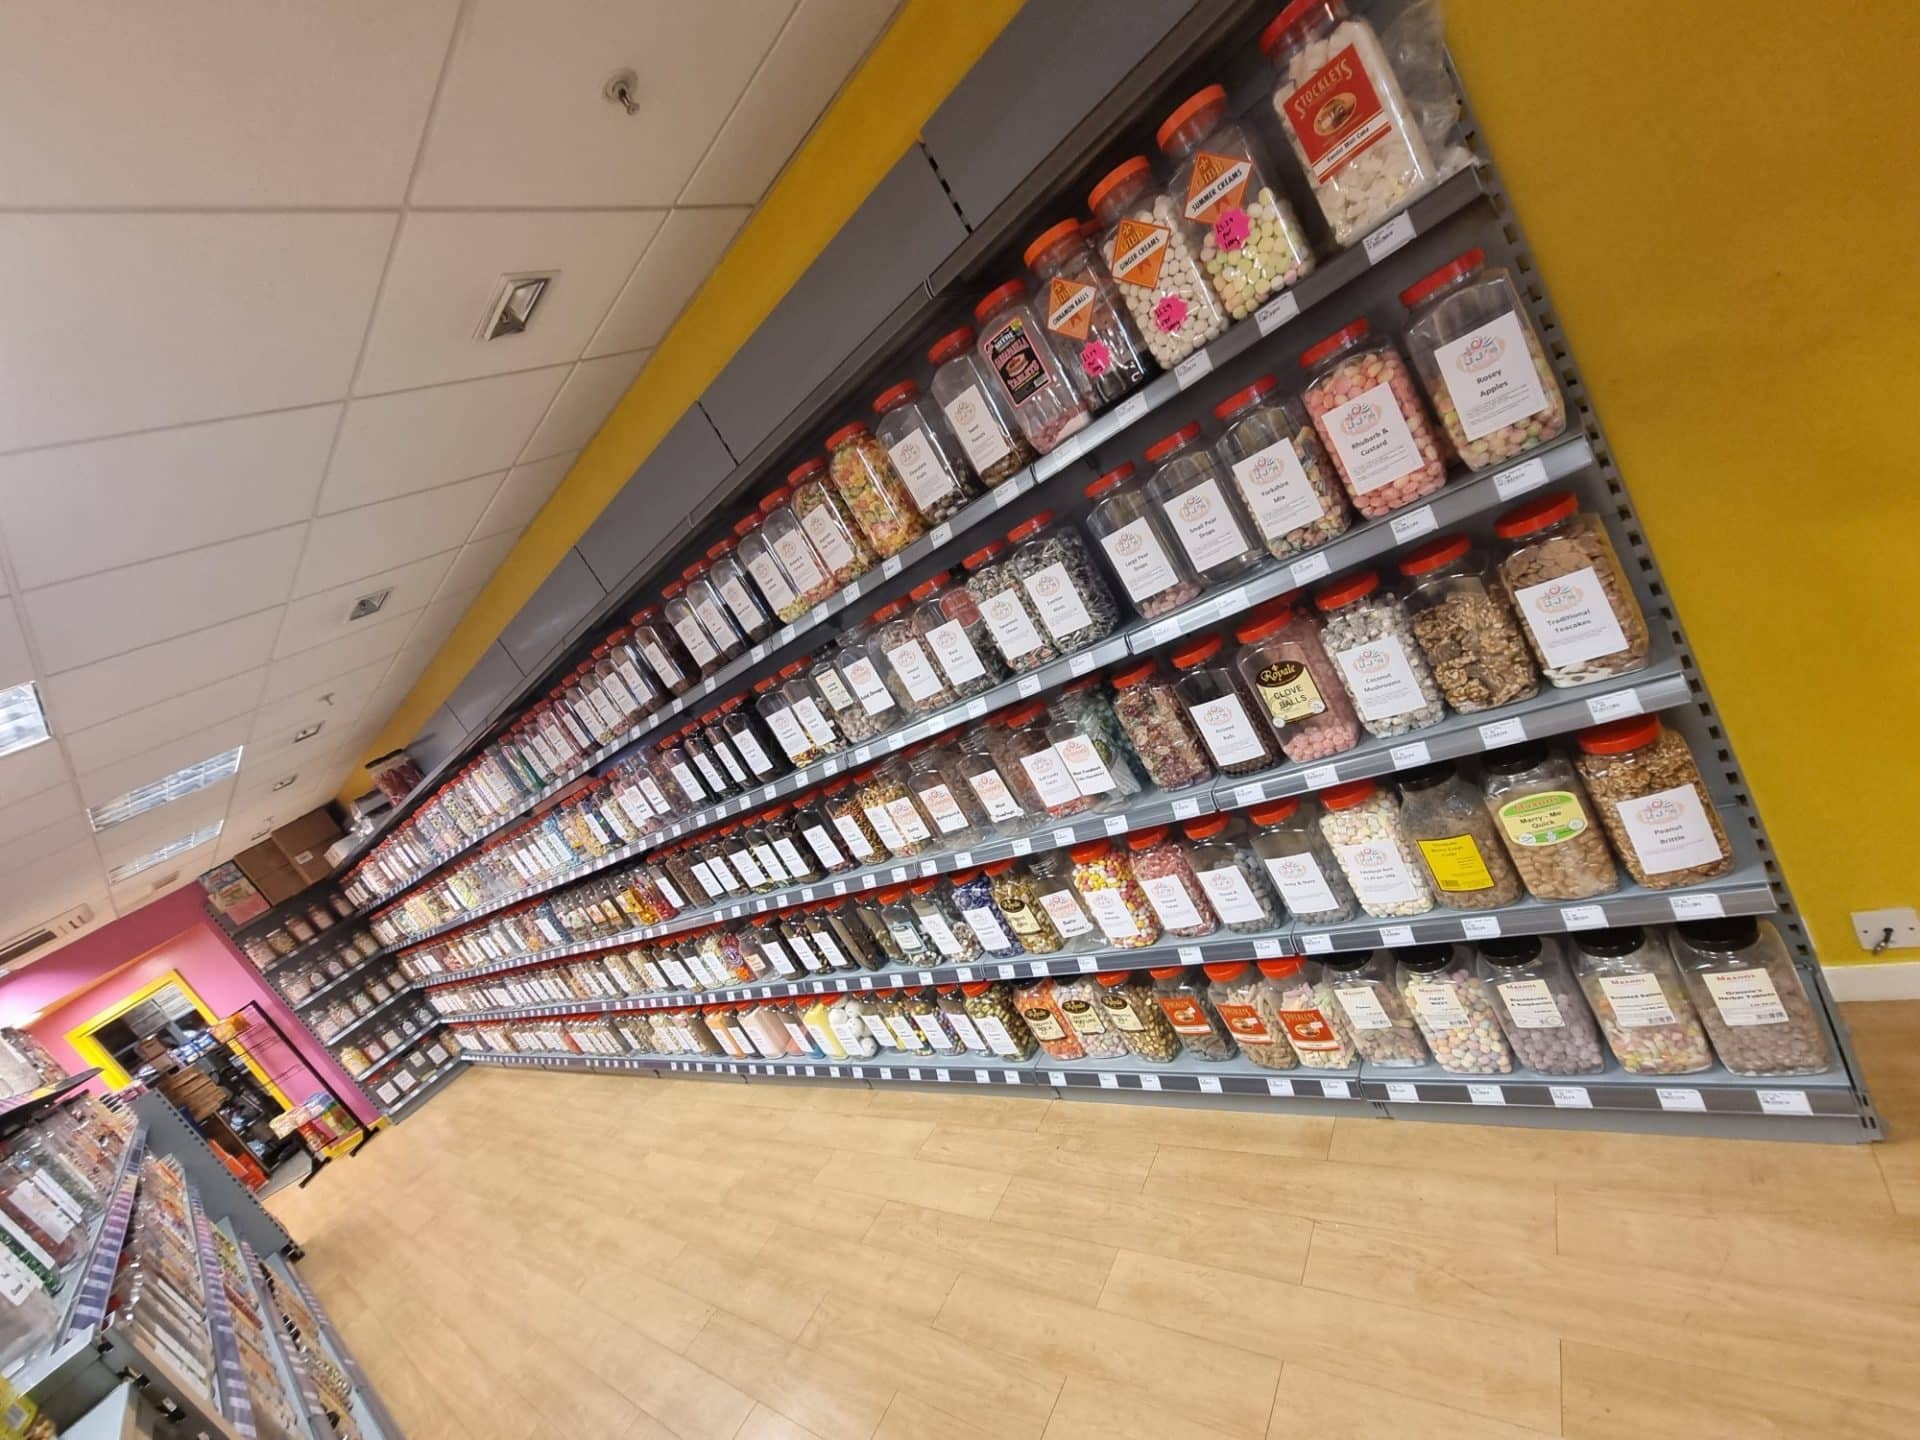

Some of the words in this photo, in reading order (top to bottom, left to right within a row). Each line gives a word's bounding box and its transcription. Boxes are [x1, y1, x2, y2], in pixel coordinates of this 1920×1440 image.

[1293, 58, 1353, 120] STOCKLEYS
[1191, 190, 1217, 212] SUMMER
[1217, 169, 1243, 192] CREAMS
[1119, 251, 1142, 273] GINGER
[1139, 236, 1161, 256] CREAMS
[1052, 301, 1075, 325] CINNAMON
[1074, 292, 1090, 307] BALLS
[1476, 368, 1502, 385] Rosey
[1479, 380, 1509, 399] Apples
[1350, 431, 1381, 450] Rhubarb
[1380, 427, 1389, 435] &
[1359, 439, 1388, 457] Custard
[1261, 480, 1289, 497] Yorkshire
[1272, 494, 1286, 504] Mix
[1189, 522, 1204, 534] Small
[1547, 608, 1592, 626] Traditional
[1554, 618, 1592, 634] Teacakes
[1272, 682, 1303, 701] CLOVE
[1363, 679, 1402, 694] Mushrooms
[1279, 693, 1307, 708] BALLS
[1520, 814, 1542, 824] Marry
[1549, 809, 1562, 817] Me
[1531, 819, 1555, 829] Quick
[1653, 825, 1682, 836] Peanut
[1659, 835, 1686, 845] Brittle
[1716, 974, 1755, 982] Maxons
